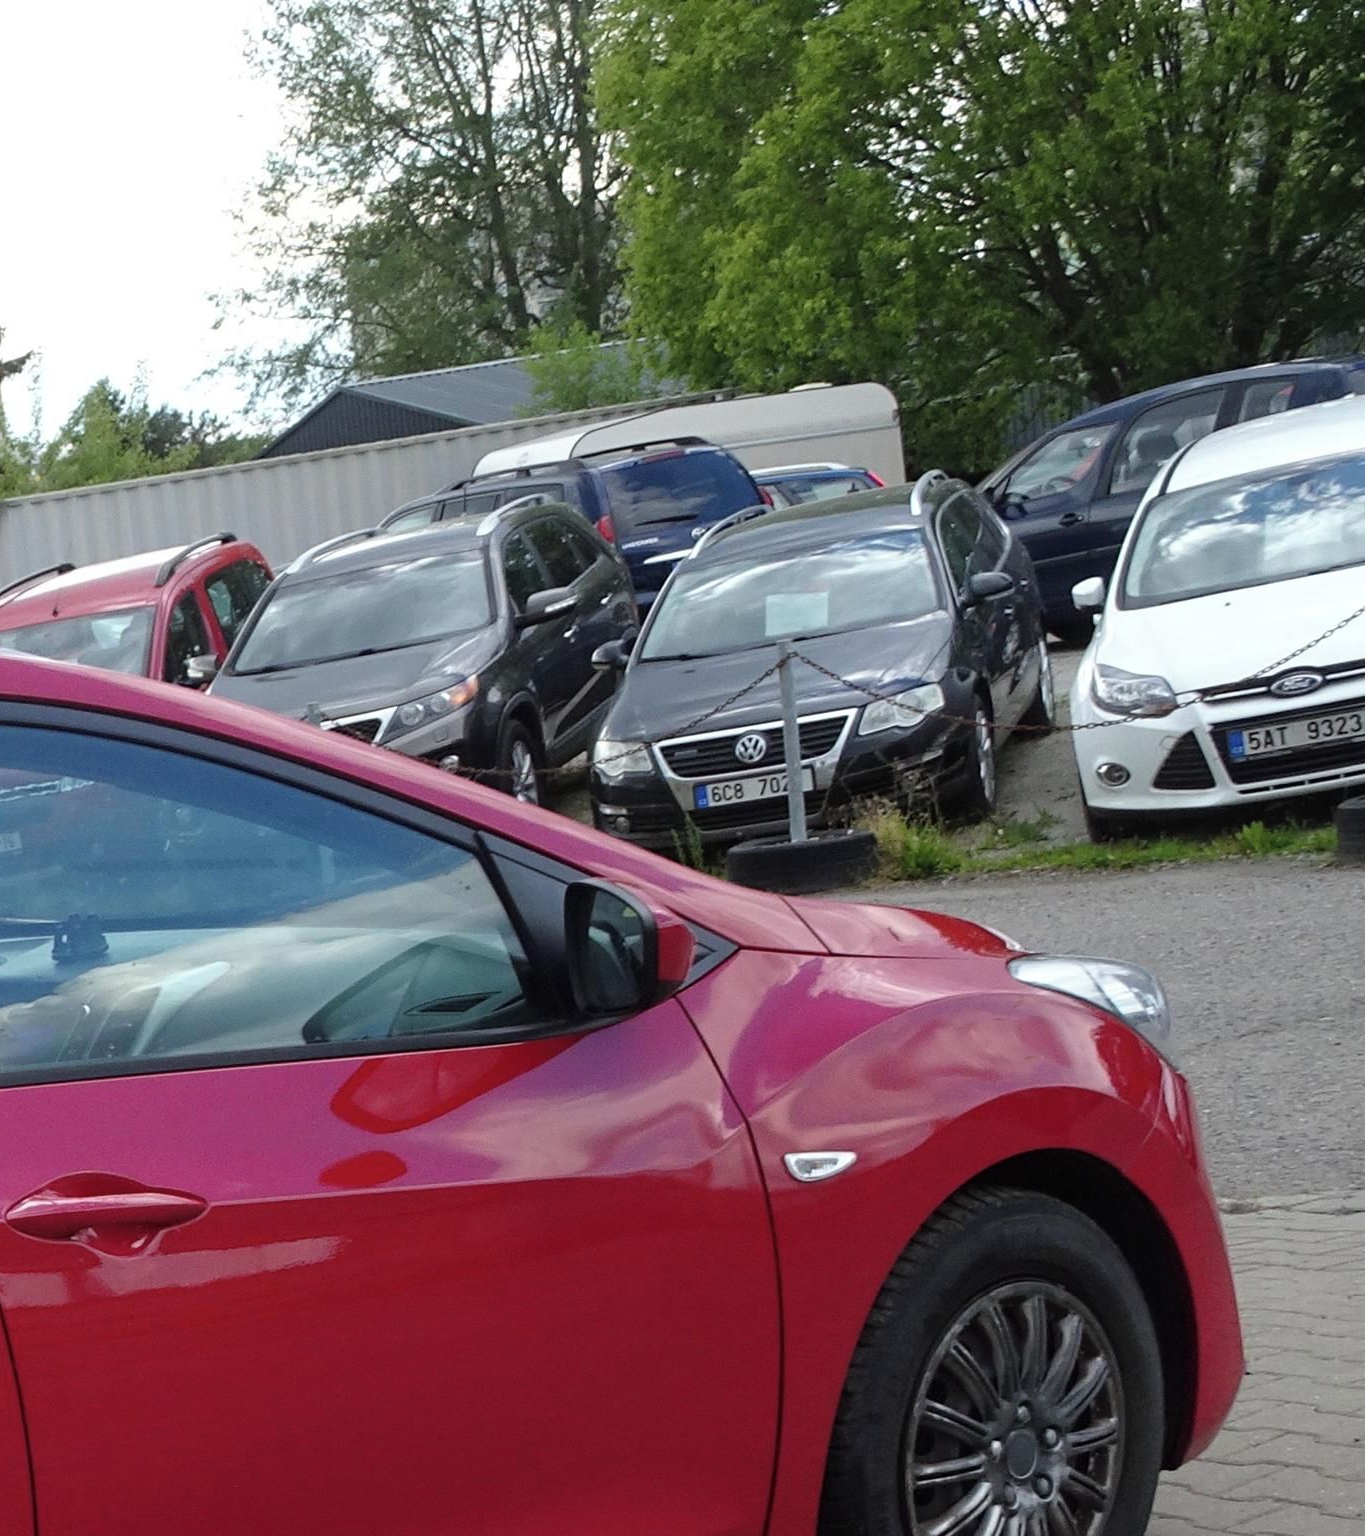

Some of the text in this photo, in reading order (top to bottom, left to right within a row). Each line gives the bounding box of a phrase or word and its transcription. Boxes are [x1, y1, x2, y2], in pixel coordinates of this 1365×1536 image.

[1248, 726, 1288, 750] 5AT
[1307, 714, 1363, 740] 9323
[711, 783, 744, 803] 6C8
